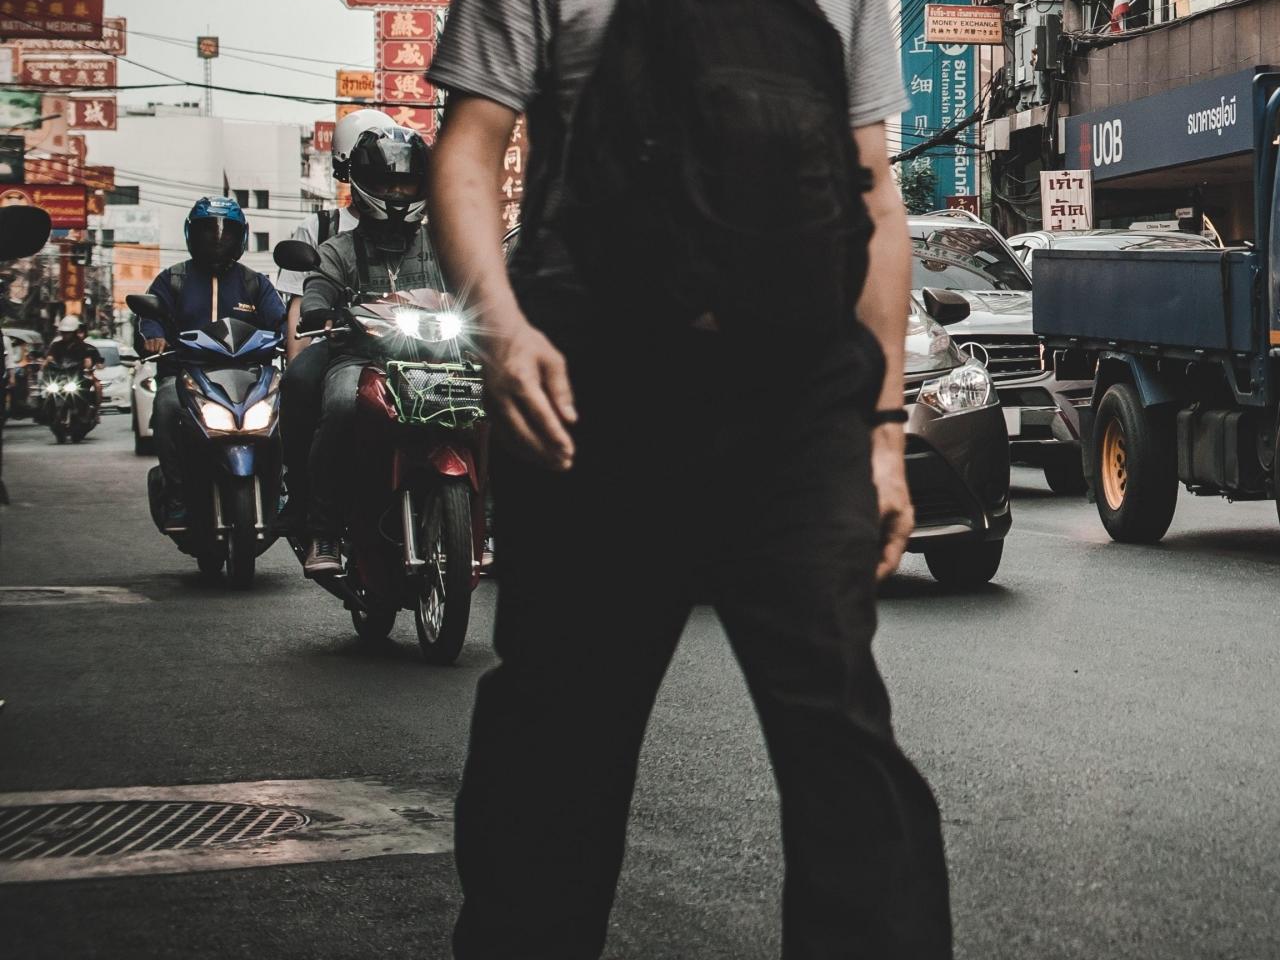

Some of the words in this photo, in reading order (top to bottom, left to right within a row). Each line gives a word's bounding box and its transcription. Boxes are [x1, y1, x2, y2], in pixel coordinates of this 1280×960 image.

[46, 21, 93, 32] MEDICINE
[960, 20, 998, 28] EXCHANGE
[942, 60, 951, 113] Kiatnakin
[1187, 95, 1237, 136] ธนาคารยูโอบี
[1093, 119, 1123, 167] UOB
